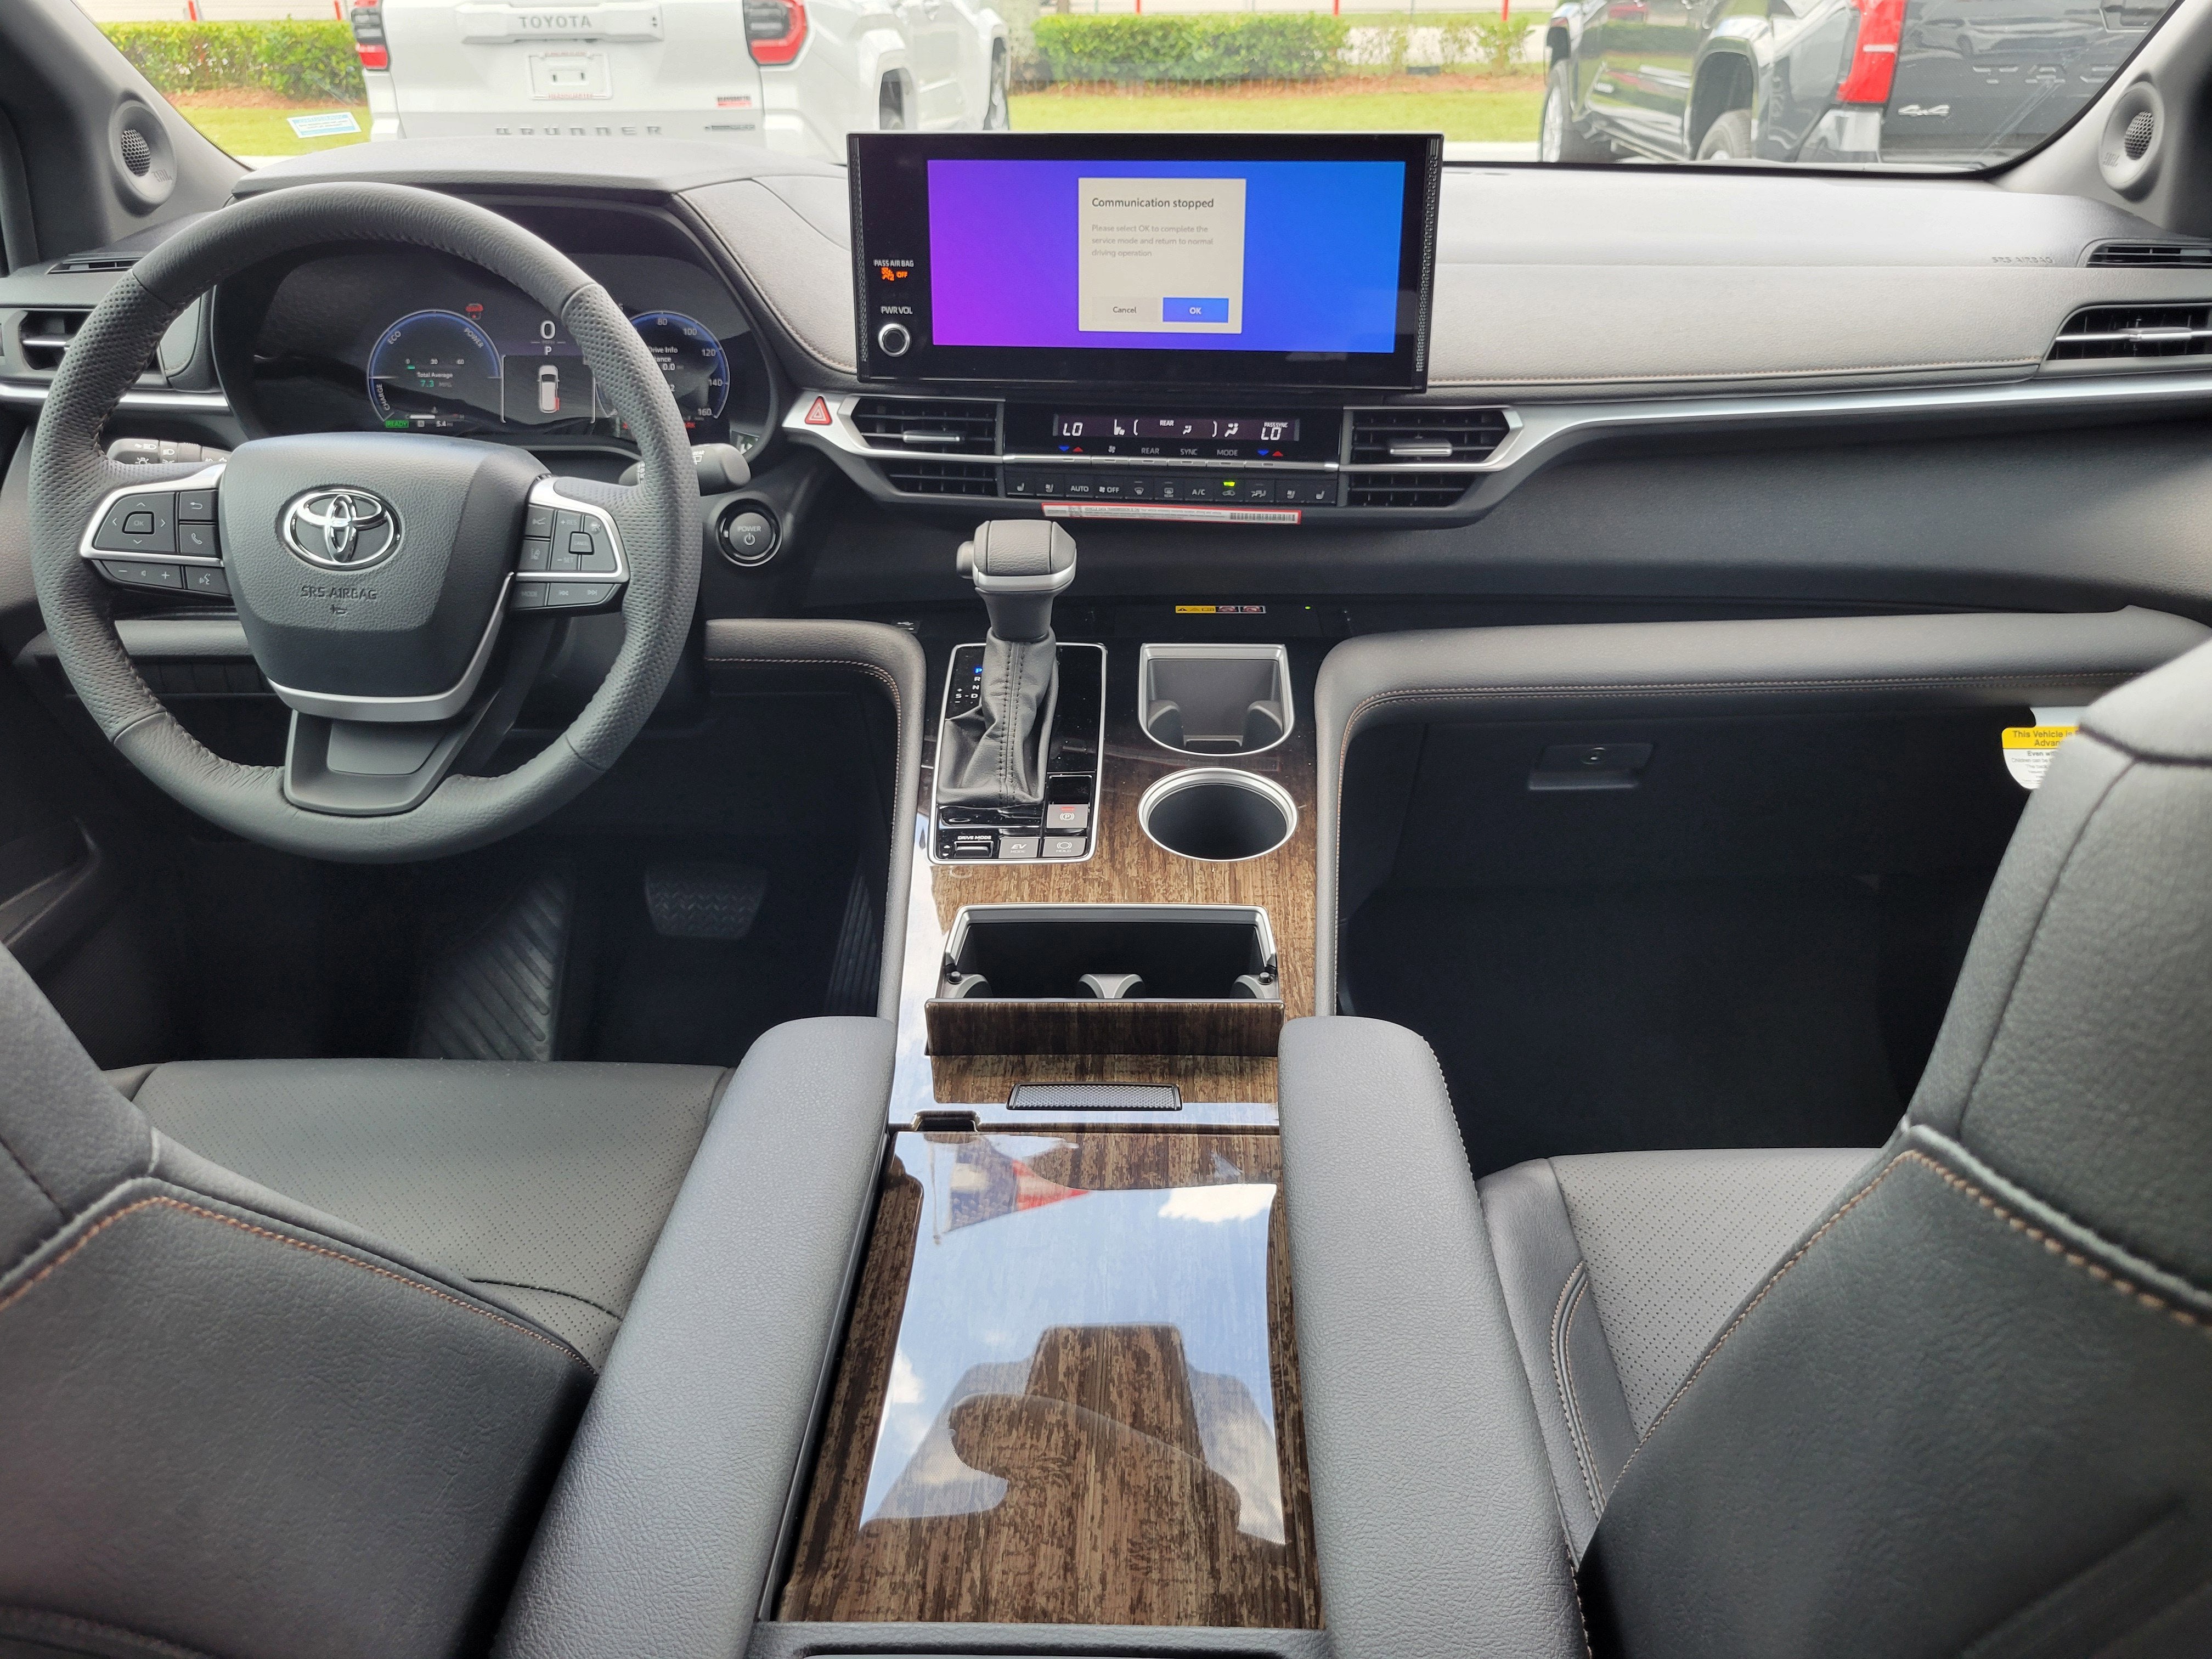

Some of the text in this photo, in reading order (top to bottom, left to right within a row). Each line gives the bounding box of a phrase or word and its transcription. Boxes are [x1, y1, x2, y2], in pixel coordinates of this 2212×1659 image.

[519, 16, 592, 29] TOYOTA
[153, 169, 173, 183] JBL
[1092, 198, 1214, 210] Communication stopped
[1092, 224, 1115, 233] Please
[1116, 224, 1137, 233] select
[1161, 225, 1194, 235] complete
[1092, 249, 1152, 258] driving operation
[881, 306, 913, 314] PWR VOL
[540, 320, 556, 340] 0
[387, 331, 401, 345] ECO
[464, 328, 484, 348] POWER
[544, 345, 552, 356] P
[702, 348, 716, 357] 120
[376, 383, 391, 411] CHARGE
[1063, 422, 1083, 436] LO
[1261, 427, 1282, 441] LO
[301, 585, 377, 600] SRS AIRBAG
